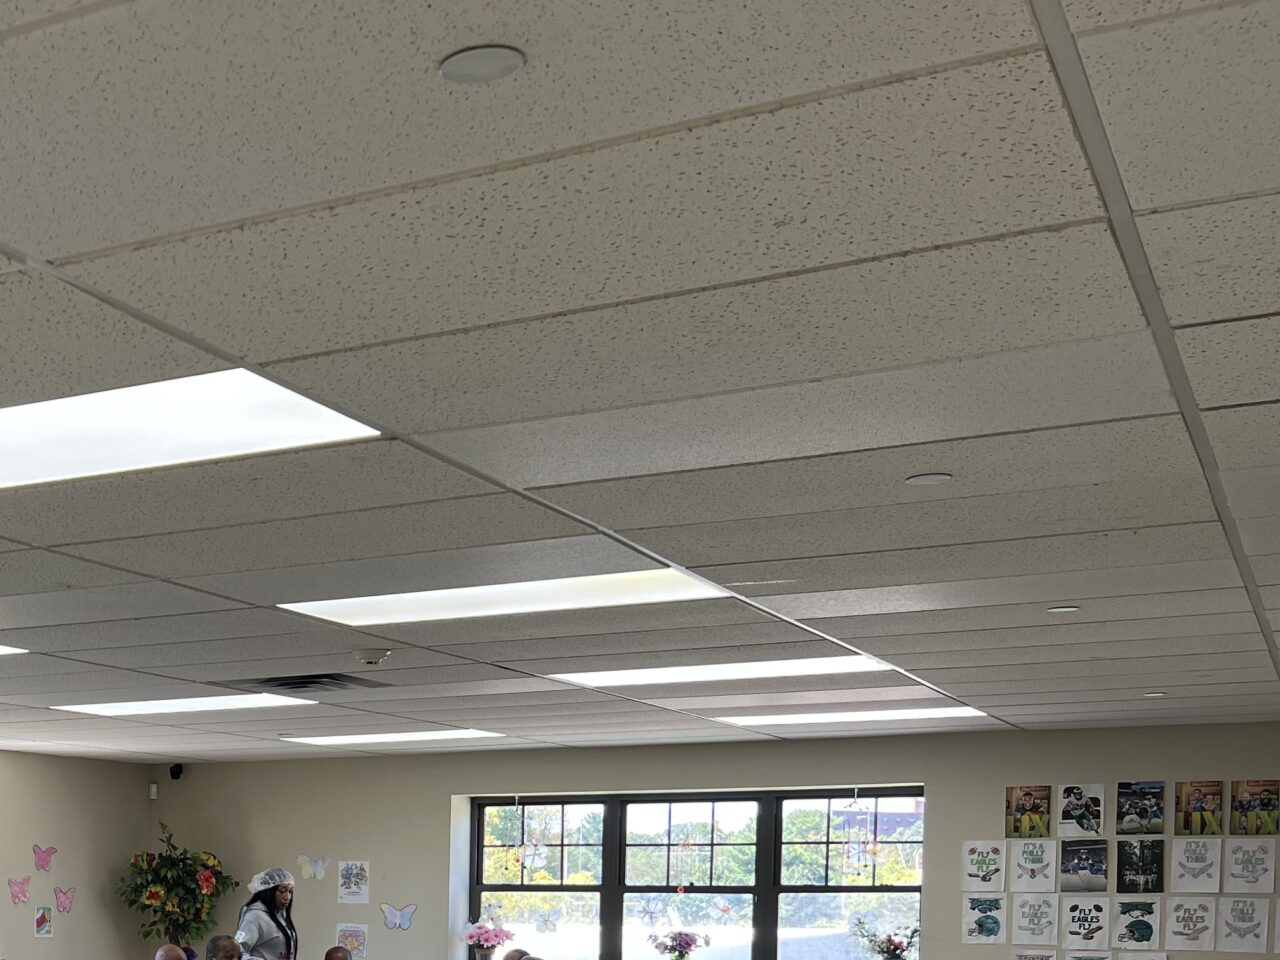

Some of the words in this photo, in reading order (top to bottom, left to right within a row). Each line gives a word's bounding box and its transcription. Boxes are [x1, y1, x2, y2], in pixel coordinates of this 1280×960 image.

[1079, 908, 1092, 916] FLY
[1184, 908, 1198, 916] FLY
[1071, 915, 1100, 923] EAGLES
[1176, 915, 1205, 923] EAGLES
[1079, 923, 1092, 931] FLY
[1183, 923, 1197, 931] FLY
